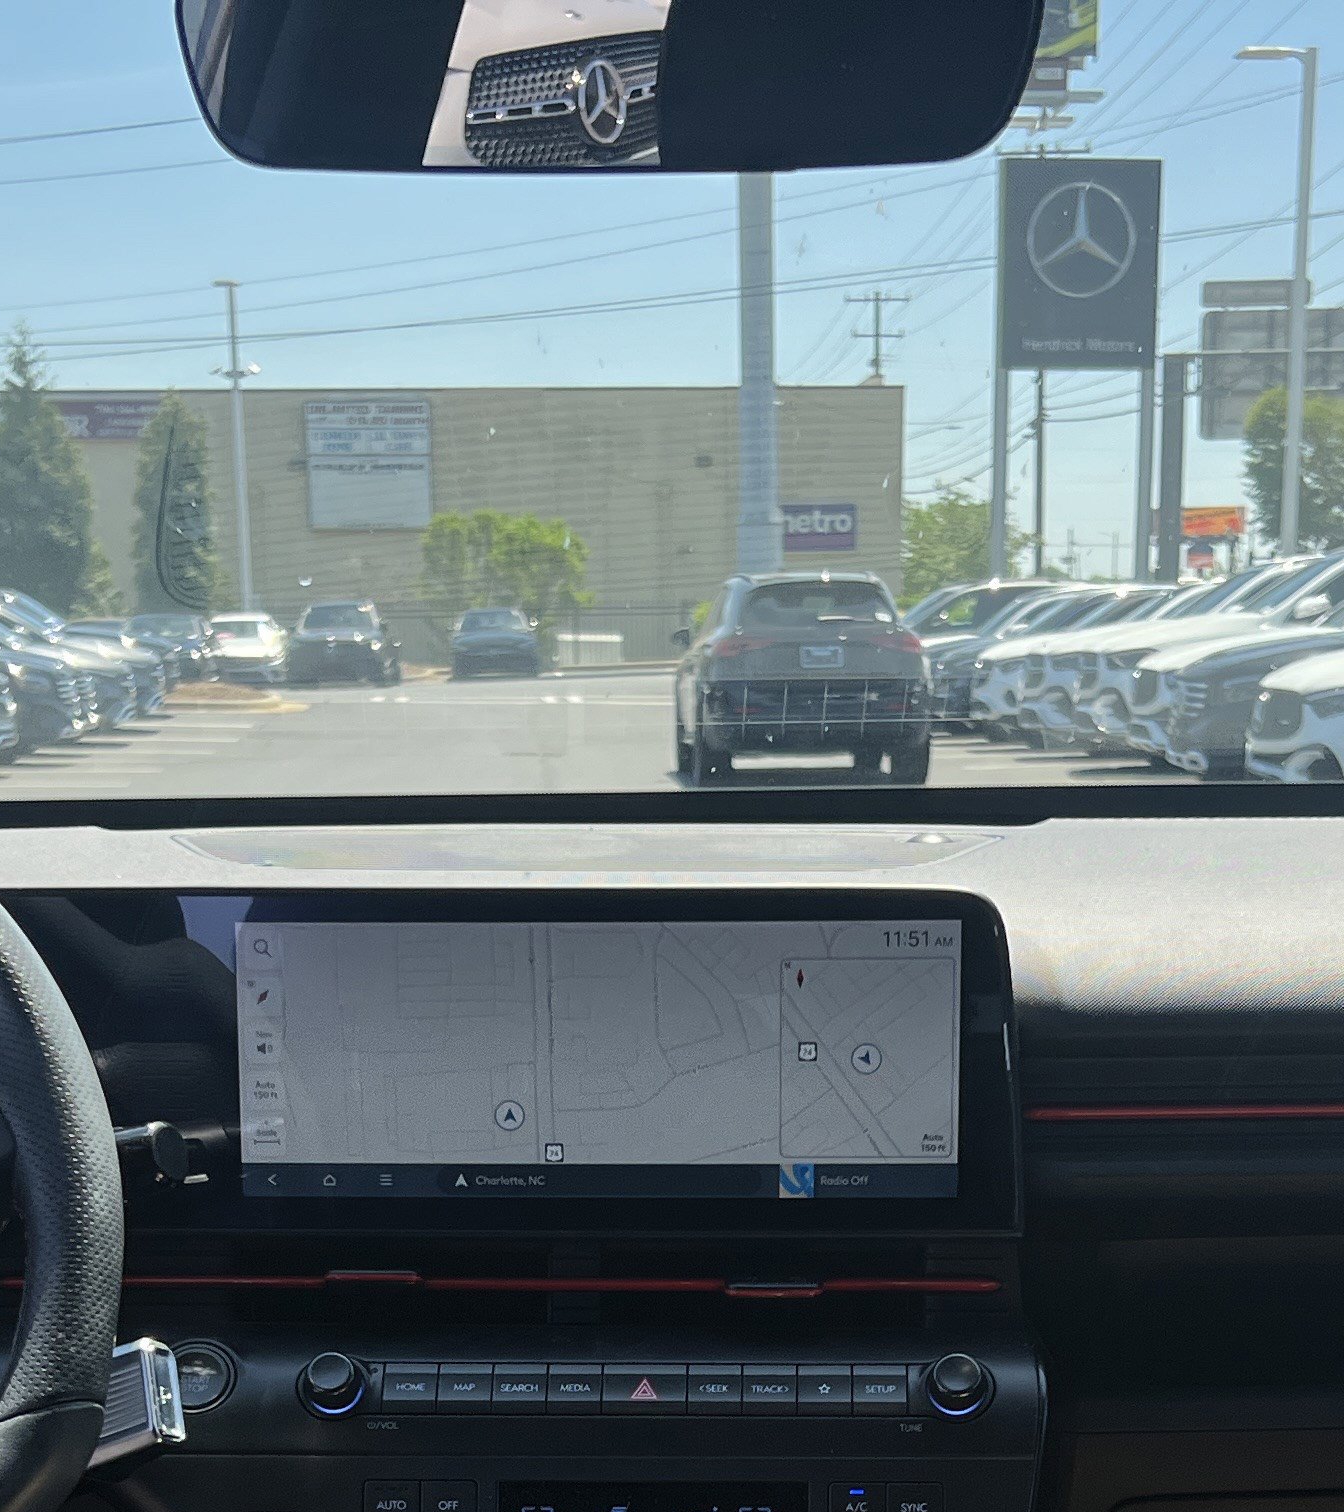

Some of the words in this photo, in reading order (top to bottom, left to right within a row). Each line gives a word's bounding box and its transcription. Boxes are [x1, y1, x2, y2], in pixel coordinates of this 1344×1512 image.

[883, 930, 930, 948] 11:51
[396, 1382, 426, 1392] HOME
[453, 1383, 476, 1392] MAP
[500, 1383, 539, 1393] SEARCH
[560, 1383, 591, 1392] MEDIA
[865, 1385, 897, 1394] SETUP
[376, 1500, 407, 1510] AUTO
[438, 1501, 458, 1510] OFF
[846, 1502, 868, 1512] A/C
[900, 1503, 928, 1512] SYNC
